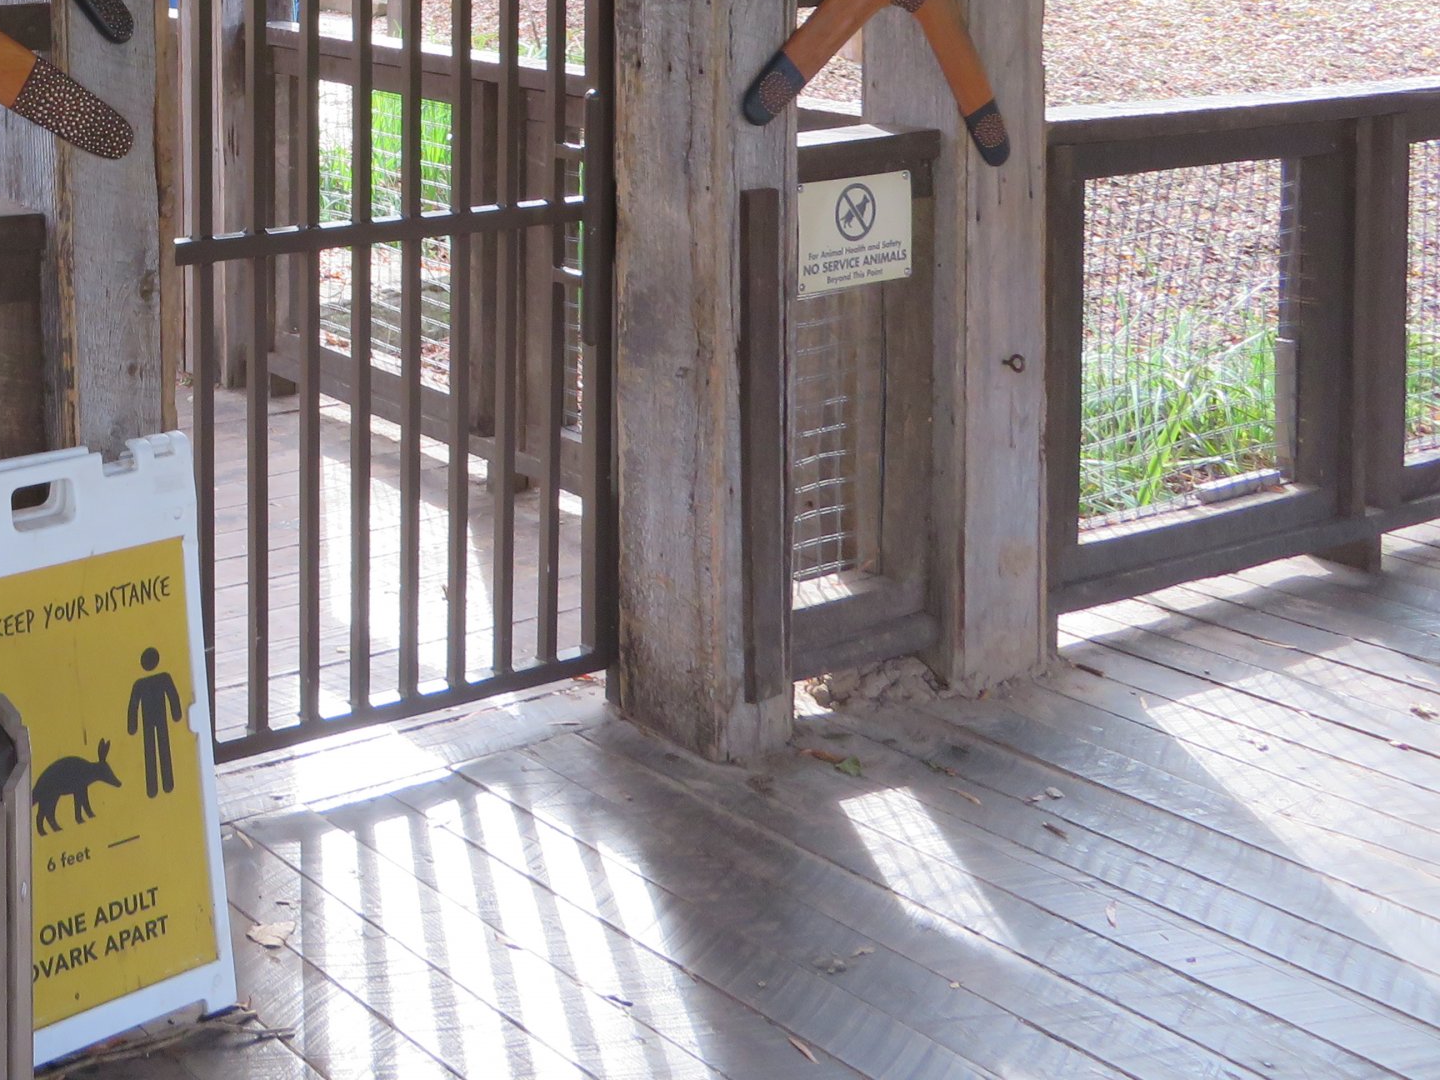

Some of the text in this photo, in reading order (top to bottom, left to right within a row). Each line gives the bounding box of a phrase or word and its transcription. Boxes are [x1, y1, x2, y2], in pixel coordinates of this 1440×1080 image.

[803, 248, 907, 277] NO SERVICE ANIMALS
[808, 239, 902, 261] For Animal Health and Safety
[826, 268, 883, 285] Beyond This Point
[44, 595, 89, 629] YOUR
[95, 575, 171, 614] DISTANCE
[47, 847, 91, 872] 6 feet
[39, 886, 159, 946] ONE ADULT
[104, 914, 169, 956] APART
